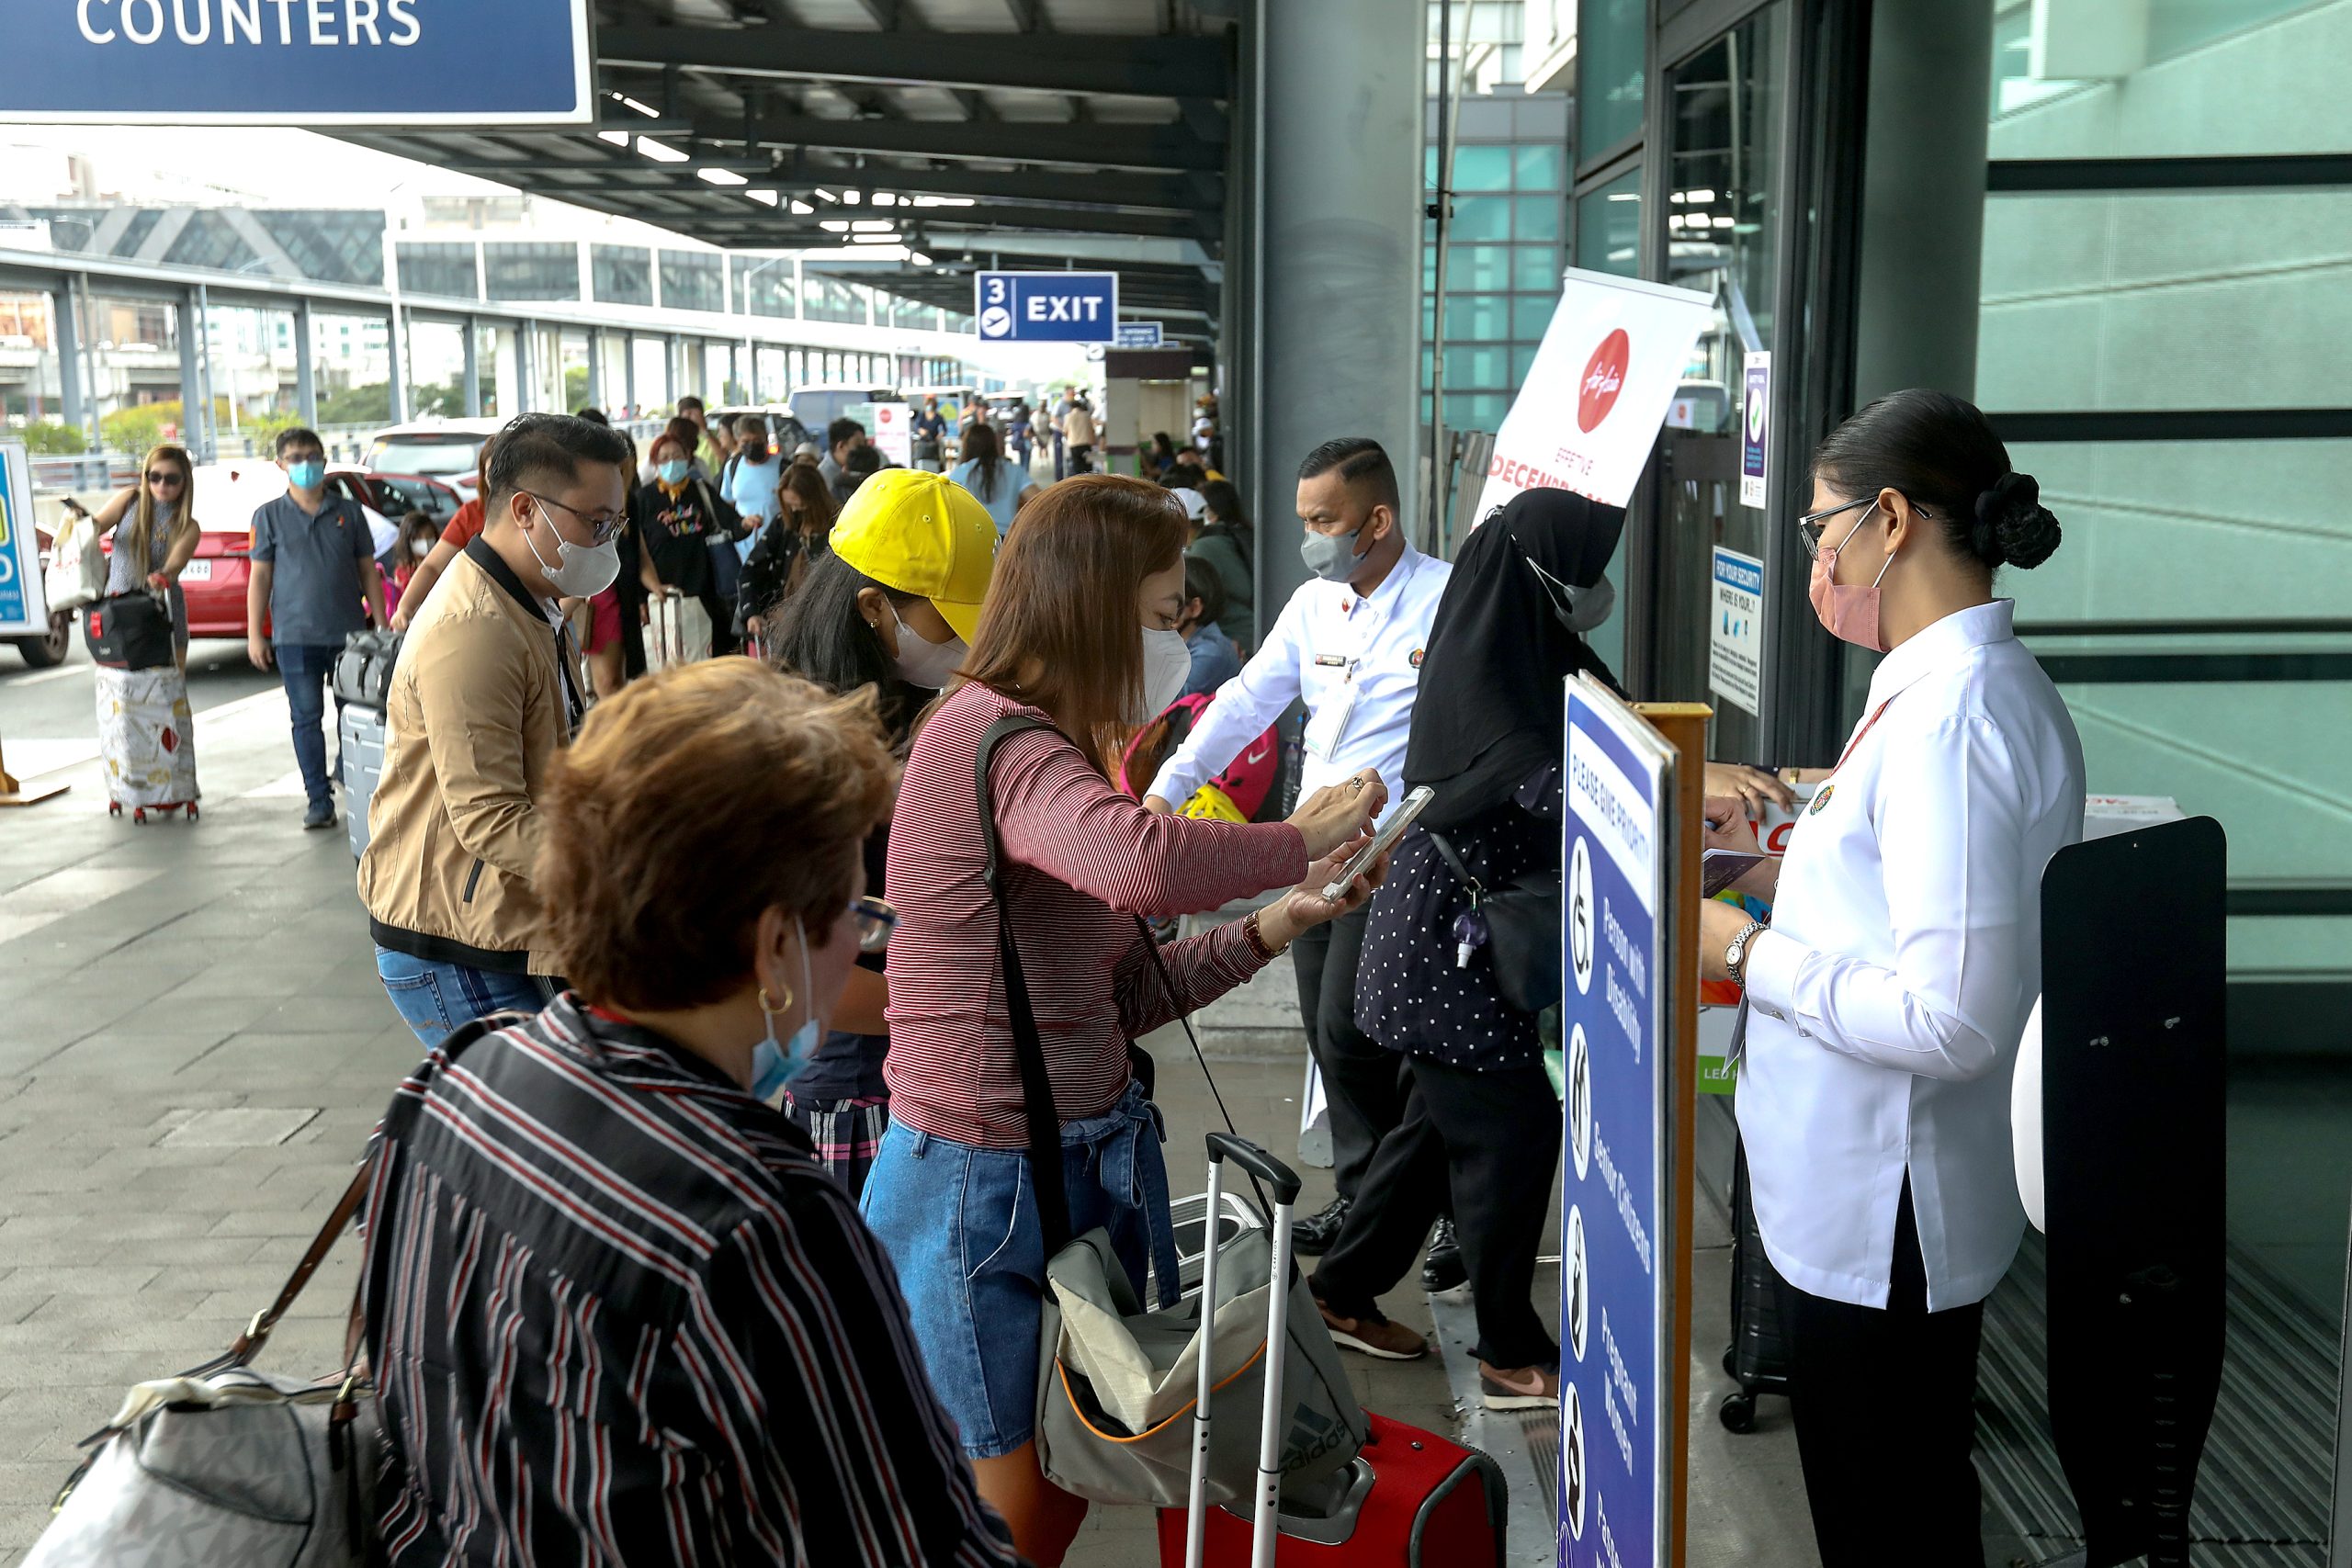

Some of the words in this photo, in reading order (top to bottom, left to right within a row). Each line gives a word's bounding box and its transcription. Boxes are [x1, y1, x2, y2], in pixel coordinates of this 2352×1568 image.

[76, 0, 422, 46] COUNTERS
[987, 278, 1006, 305] 3
[1027, 296, 1103, 321] EXIT
[1716, 559, 1726, 579] FOR
[1726, 562, 1737, 582] YOUR
[1737, 566, 1760, 591] SECURITY
[1573, 753, 1599, 807] PLEASE
[1600, 781, 1616, 827] GIVE
[1617, 801, 1650, 867] PRIORITY
[1603, 897, 1629, 970] Person
[1628, 942, 1646, 1000] with
[1606, 962, 1642, 1066] Disability
[1594, 1121, 1618, 1199] Senior
[1617, 1172, 1651, 1275] Citizens
[1602, 1305, 1637, 1427] Pregnant
[1604, 1369, 1633, 1477] Women
